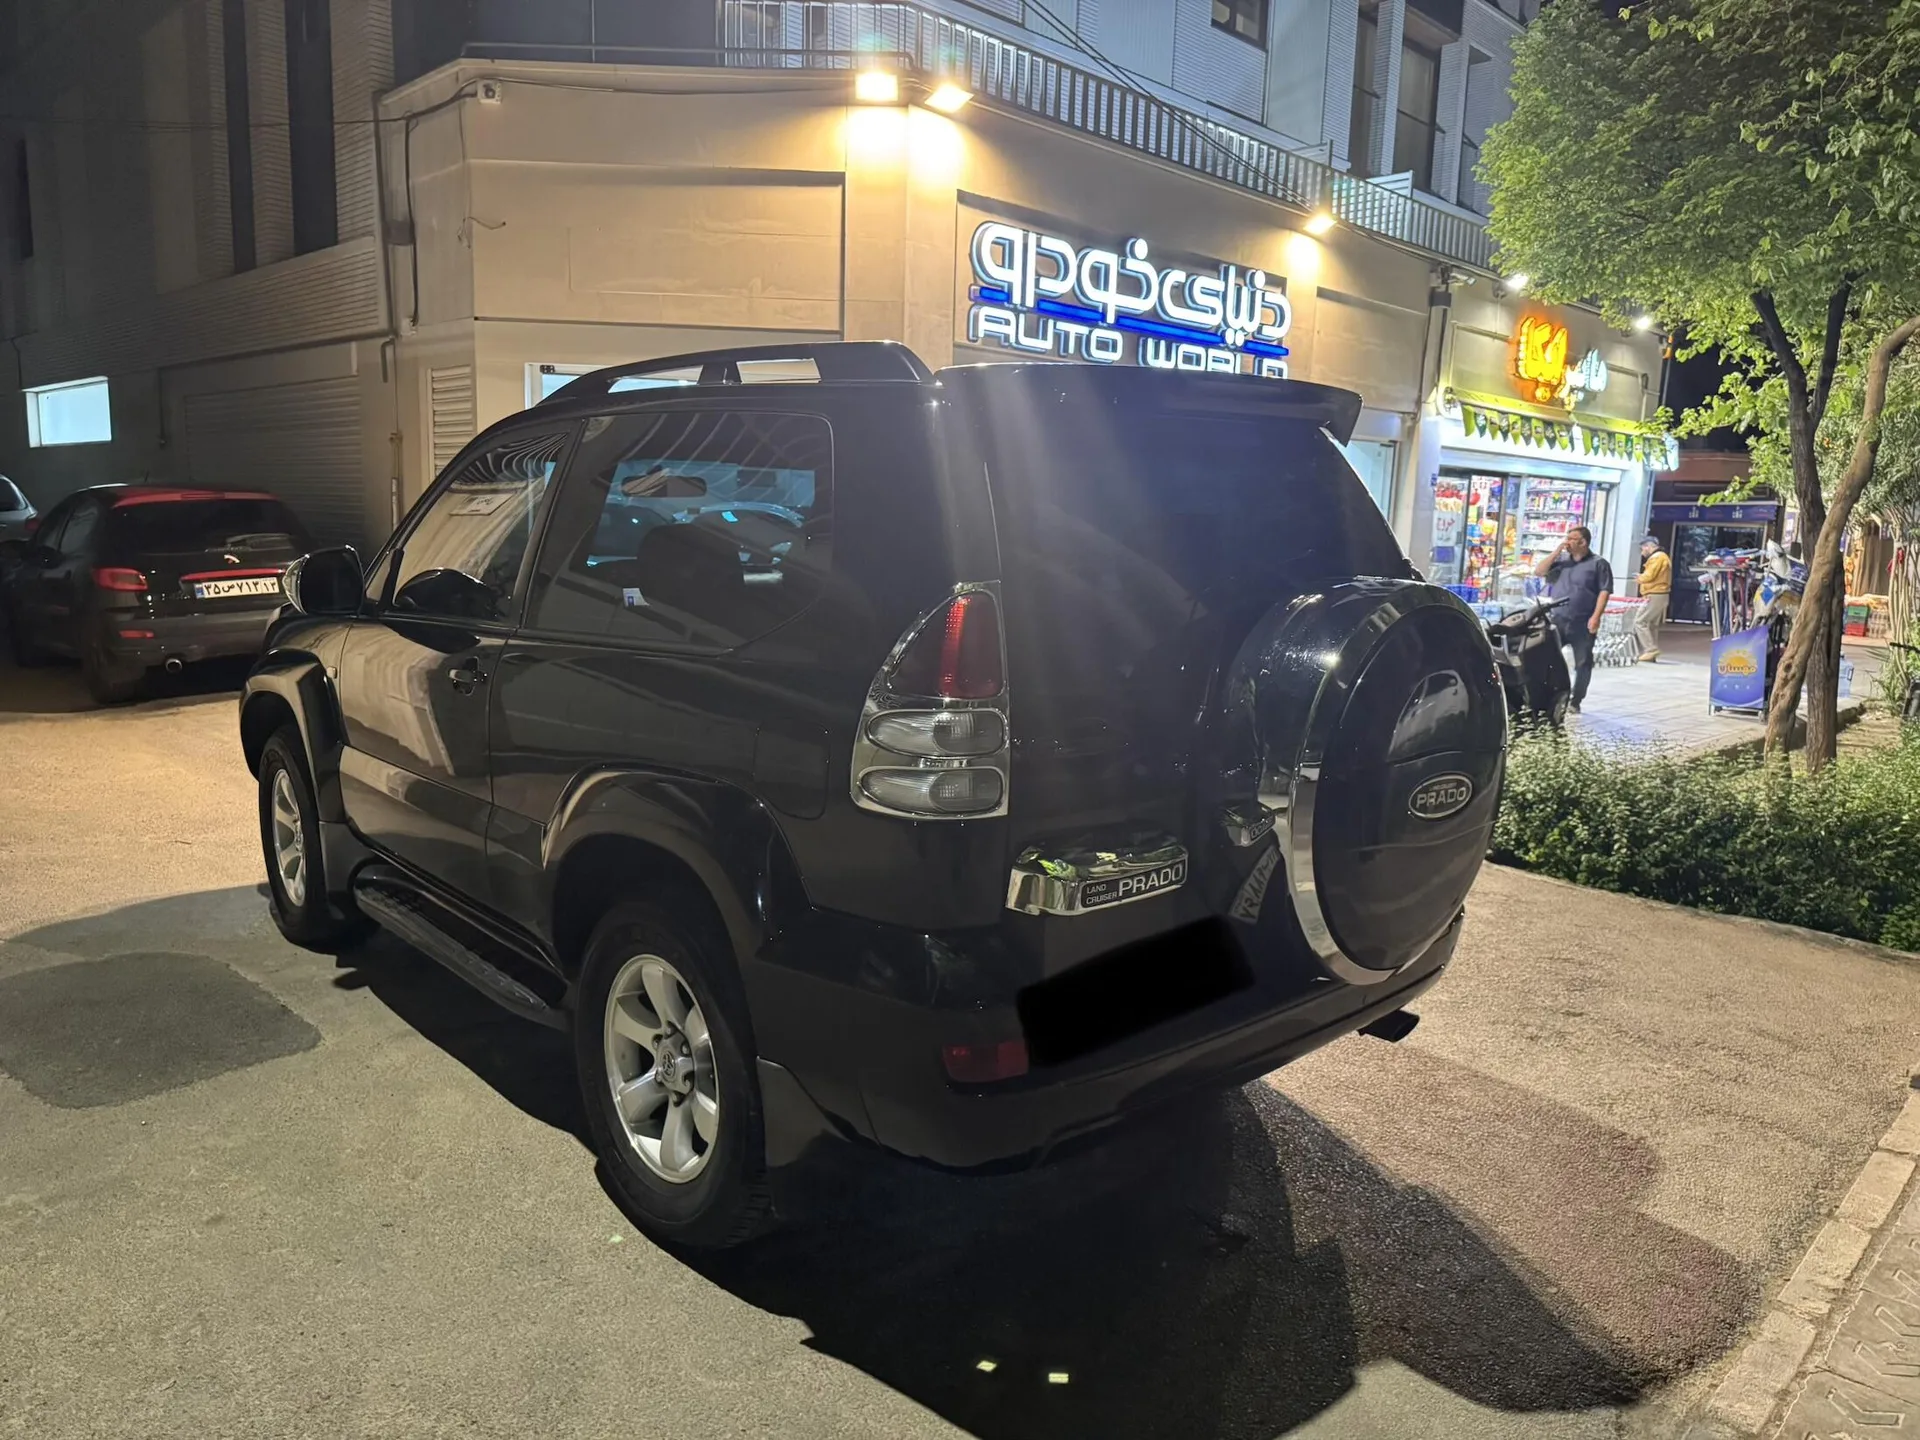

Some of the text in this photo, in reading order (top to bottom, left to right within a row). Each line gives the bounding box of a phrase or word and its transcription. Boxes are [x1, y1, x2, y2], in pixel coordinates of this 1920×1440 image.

[969, 221, 1292, 347] دنیای خودرو
[969, 306, 1125, 363] AUTO
[1416, 787, 1466, 809] PRADO
[1086, 883, 1107, 894] LAND
[1119, 863, 1183, 897] PRADO
[1086, 891, 1118, 905] CRUISER
